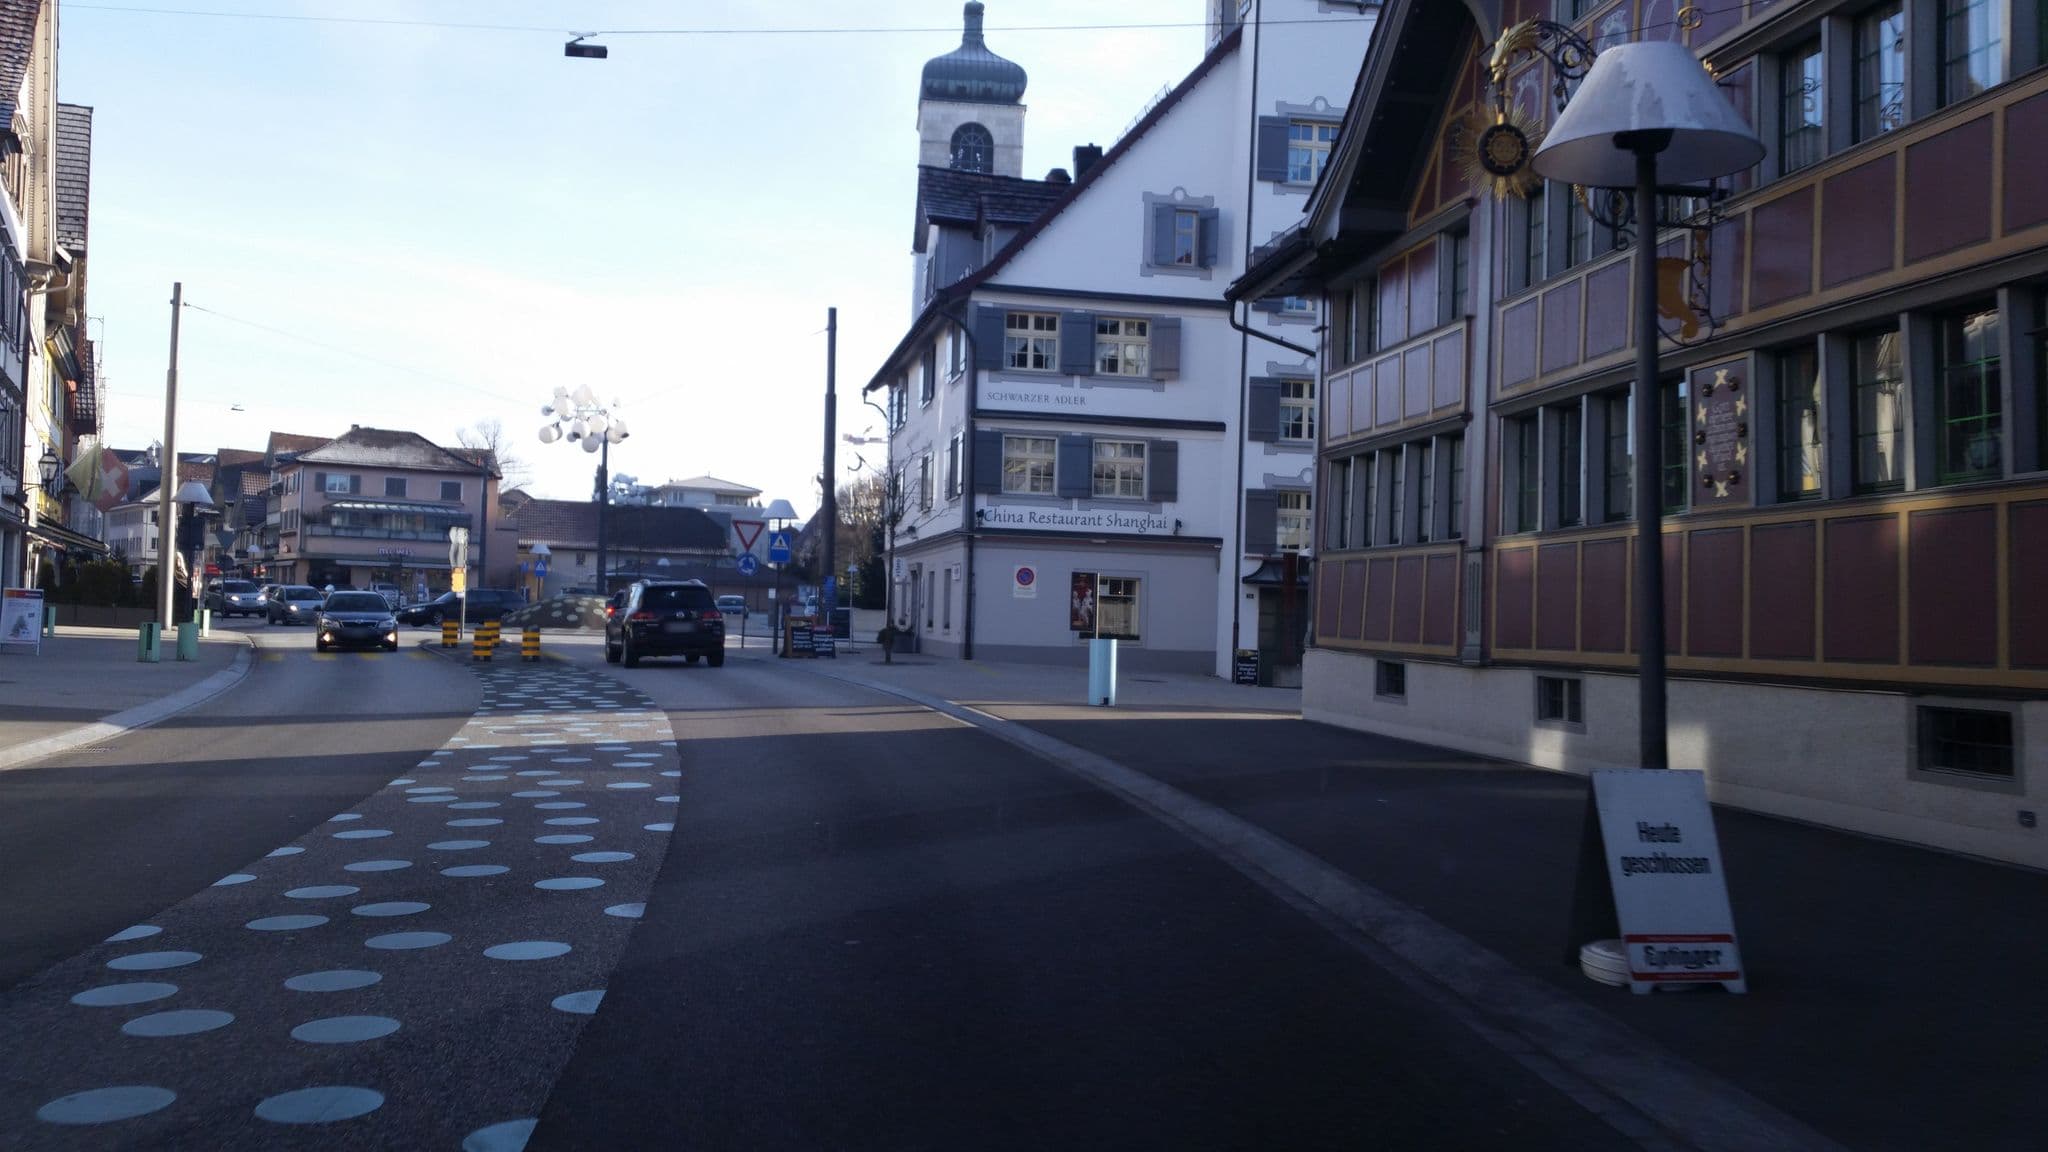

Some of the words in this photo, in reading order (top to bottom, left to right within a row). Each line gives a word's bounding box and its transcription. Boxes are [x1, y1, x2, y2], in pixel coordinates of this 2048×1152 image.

[986, 391, 1050, 403] SCHWARZER
[1055, 395, 1087, 406] ADLER
[983, 509, 1024, 525] China
[1028, 511, 1102, 528] Restaurant
[1106, 512, 1167, 533] Shanghai
[1636, 821, 1681, 842] Heute
[1620, 852, 1711, 876] geschlossen
